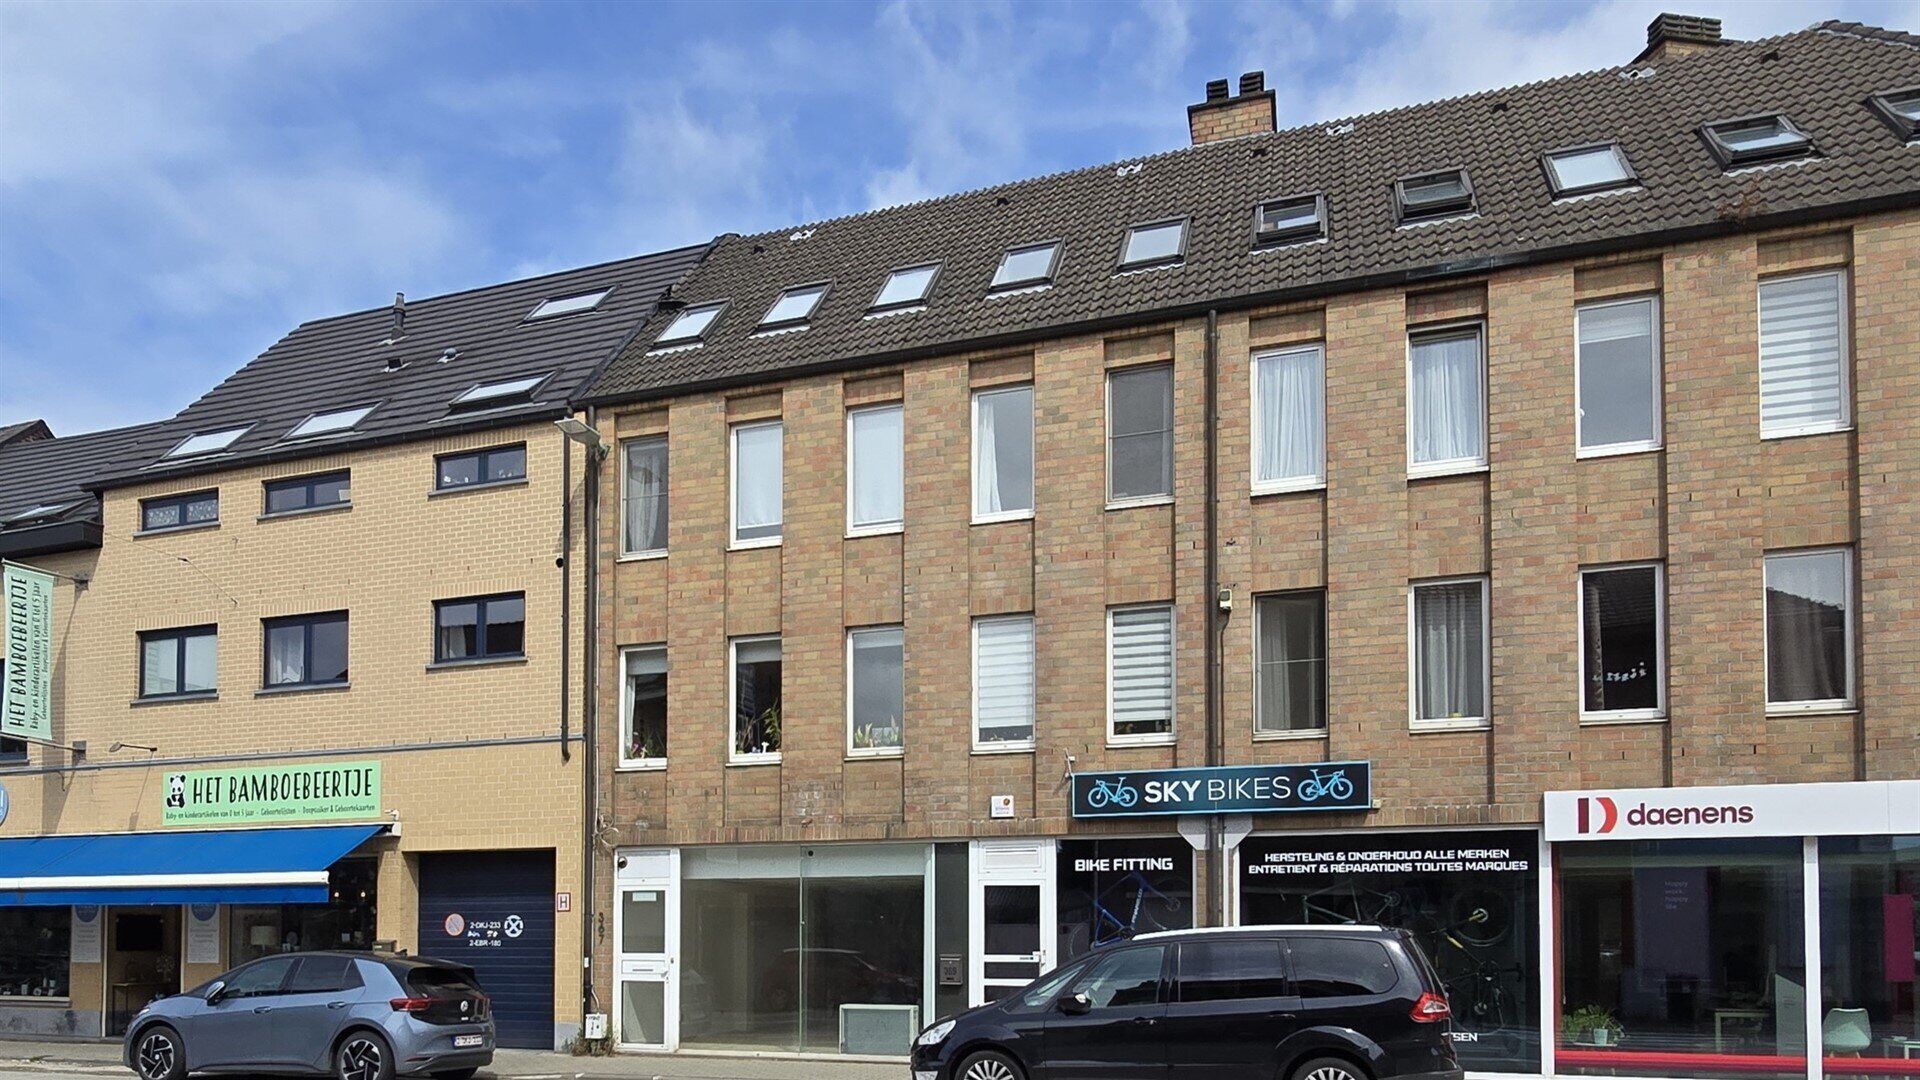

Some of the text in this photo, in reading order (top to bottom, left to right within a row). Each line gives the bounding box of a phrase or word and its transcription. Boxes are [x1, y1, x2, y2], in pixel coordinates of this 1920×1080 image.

[9, 575, 27, 727] HET BAMBOEBEERTJE
[33, 699, 39, 708] en
[193, 769, 373, 804] HET BAMBOEBEERTJE
[1144, 776, 1290, 803] SKY BIKES
[1627, 803, 1754, 826] daenens
[1265, 849, 1509, 862] HERSTELING & ONDERHOUD ALLE MERKEN
[1075, 858, 1173, 871] BIKE FITTING
[1248, 861, 1529, 874] ENTRETIENT & RÉPARATIONS TOUTES MARQUES
[559, 895, 568, 909] H
